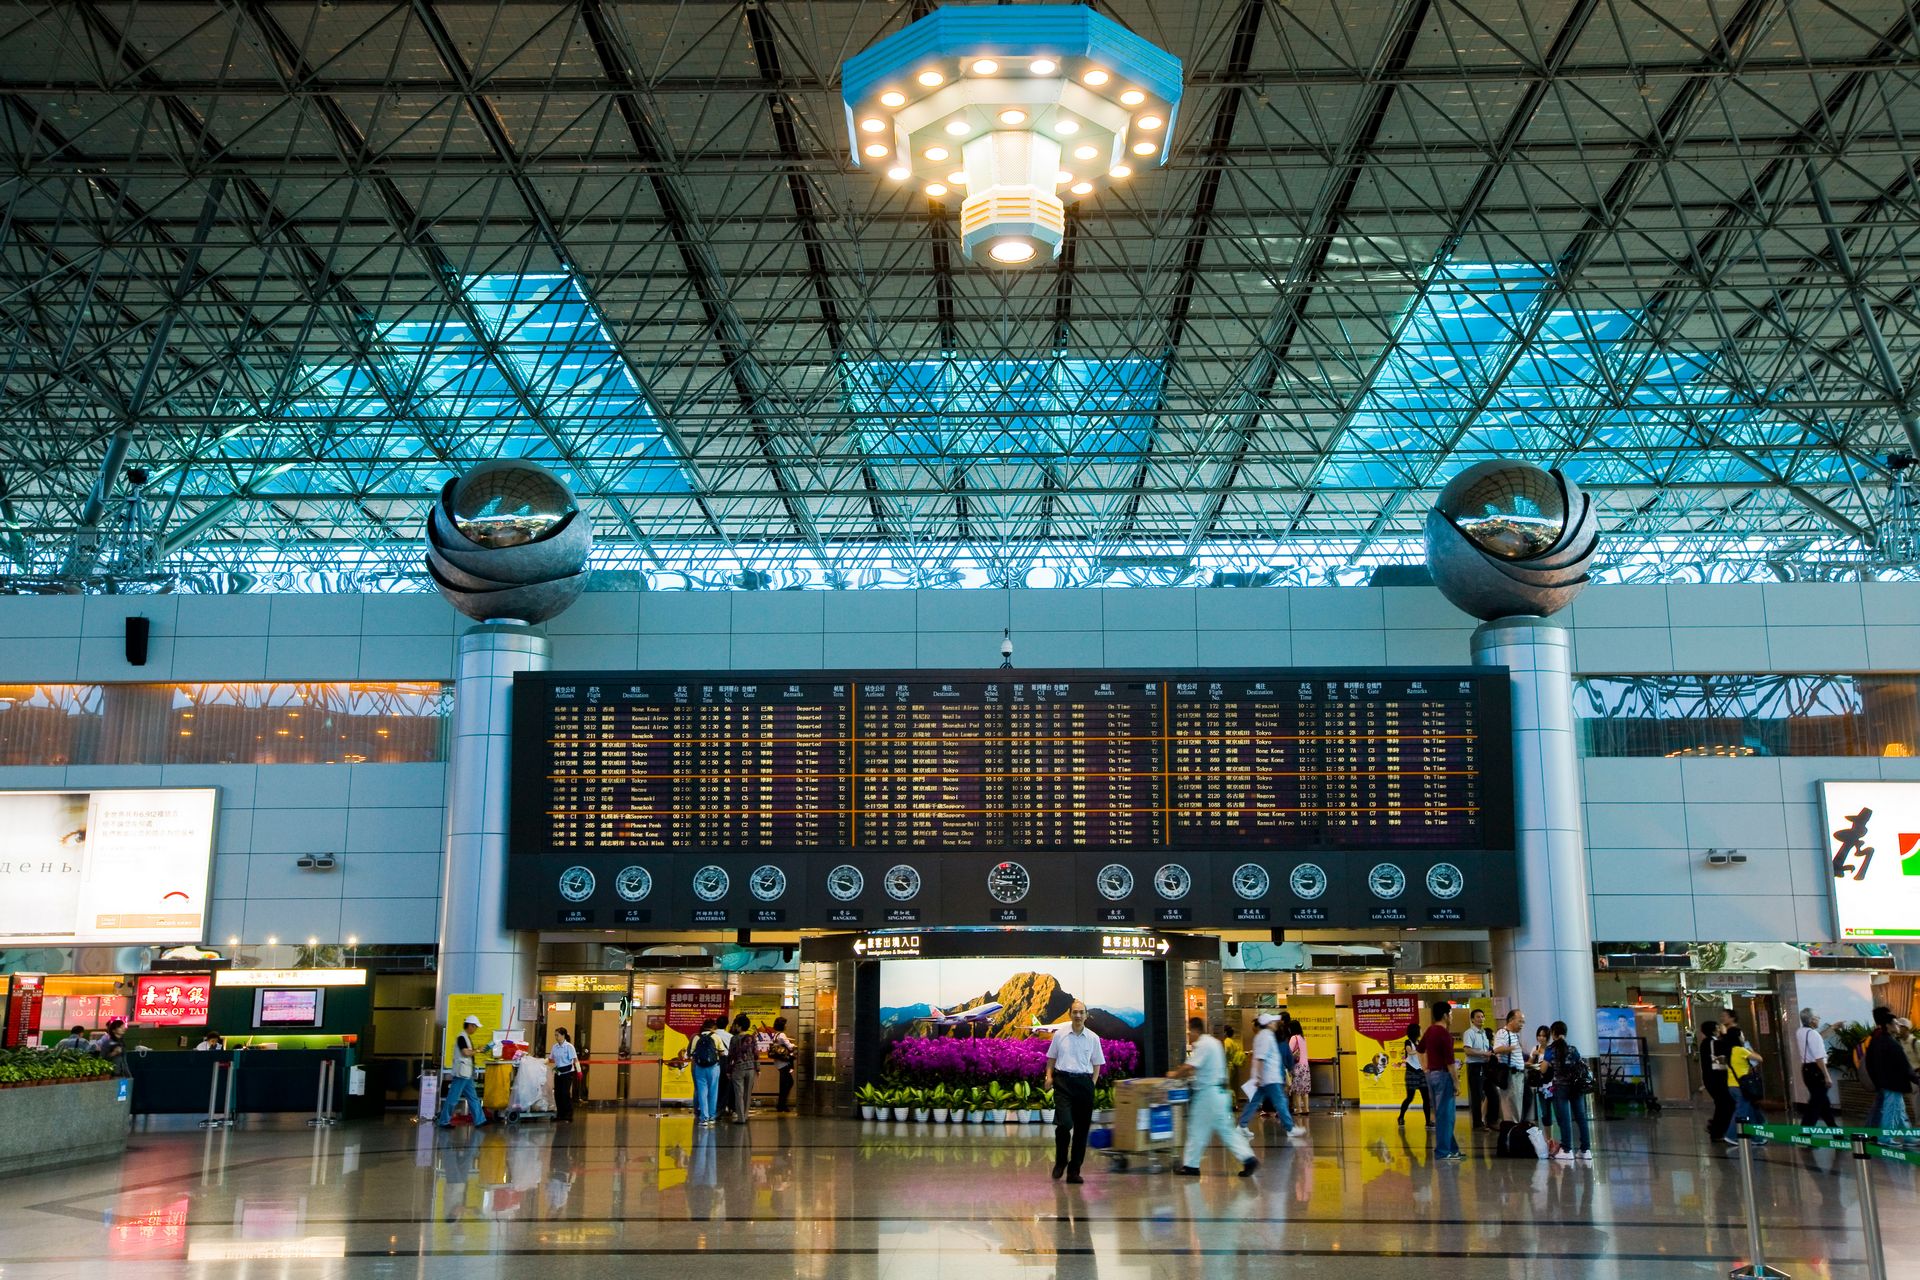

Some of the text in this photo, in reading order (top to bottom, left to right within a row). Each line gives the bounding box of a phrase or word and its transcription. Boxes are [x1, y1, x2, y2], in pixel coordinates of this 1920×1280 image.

[867, 936, 919, 948] 旅客出境入口
[1103, 936, 1155, 947] 旅客出境入口
[141, 1008, 167, 1016] BANK
[171, 1008, 185, 1016] OF
